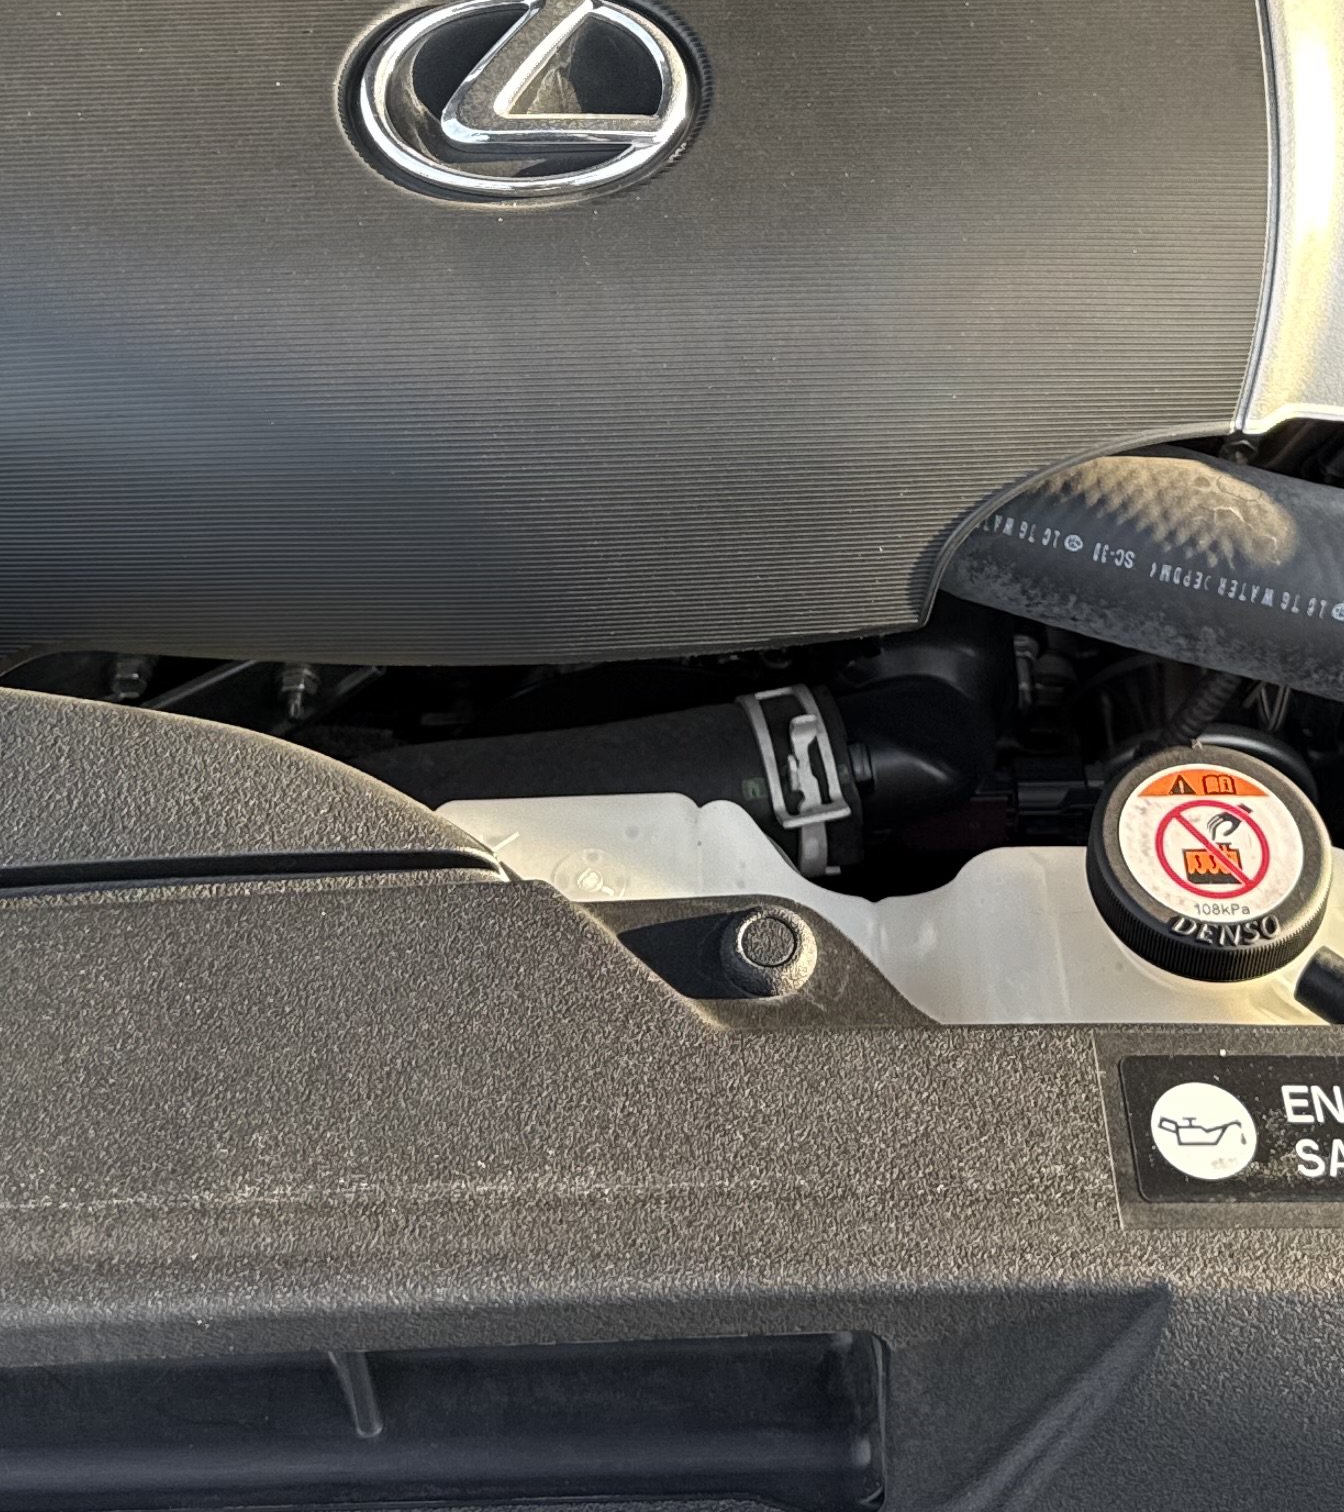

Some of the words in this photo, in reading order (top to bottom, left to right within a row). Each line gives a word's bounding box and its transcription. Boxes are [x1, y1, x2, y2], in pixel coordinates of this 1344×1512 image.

[1217, 576, 1275, 607] WATER
[1194, 902, 1251, 916] 108kPa
[1167, 914, 1281, 947] DENSO
